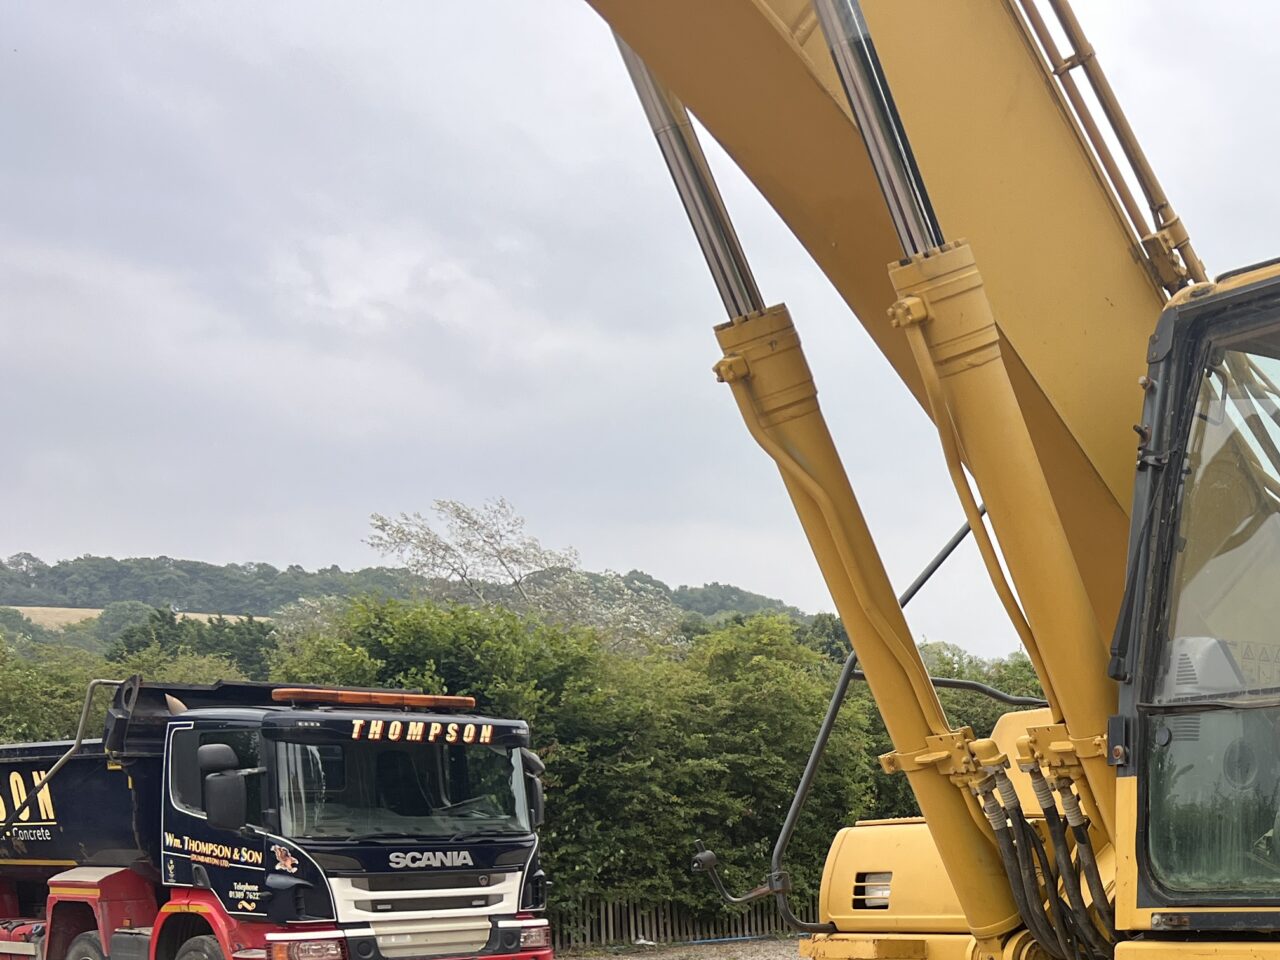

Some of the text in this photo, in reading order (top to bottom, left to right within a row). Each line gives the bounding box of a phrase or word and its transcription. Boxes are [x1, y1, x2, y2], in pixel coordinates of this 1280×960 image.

[351, 719, 495, 744] THOMPSON
[164, 832, 182, 848] Wm.
[233, 848, 240, 860] &
[389, 850, 474, 869] SCANIA
